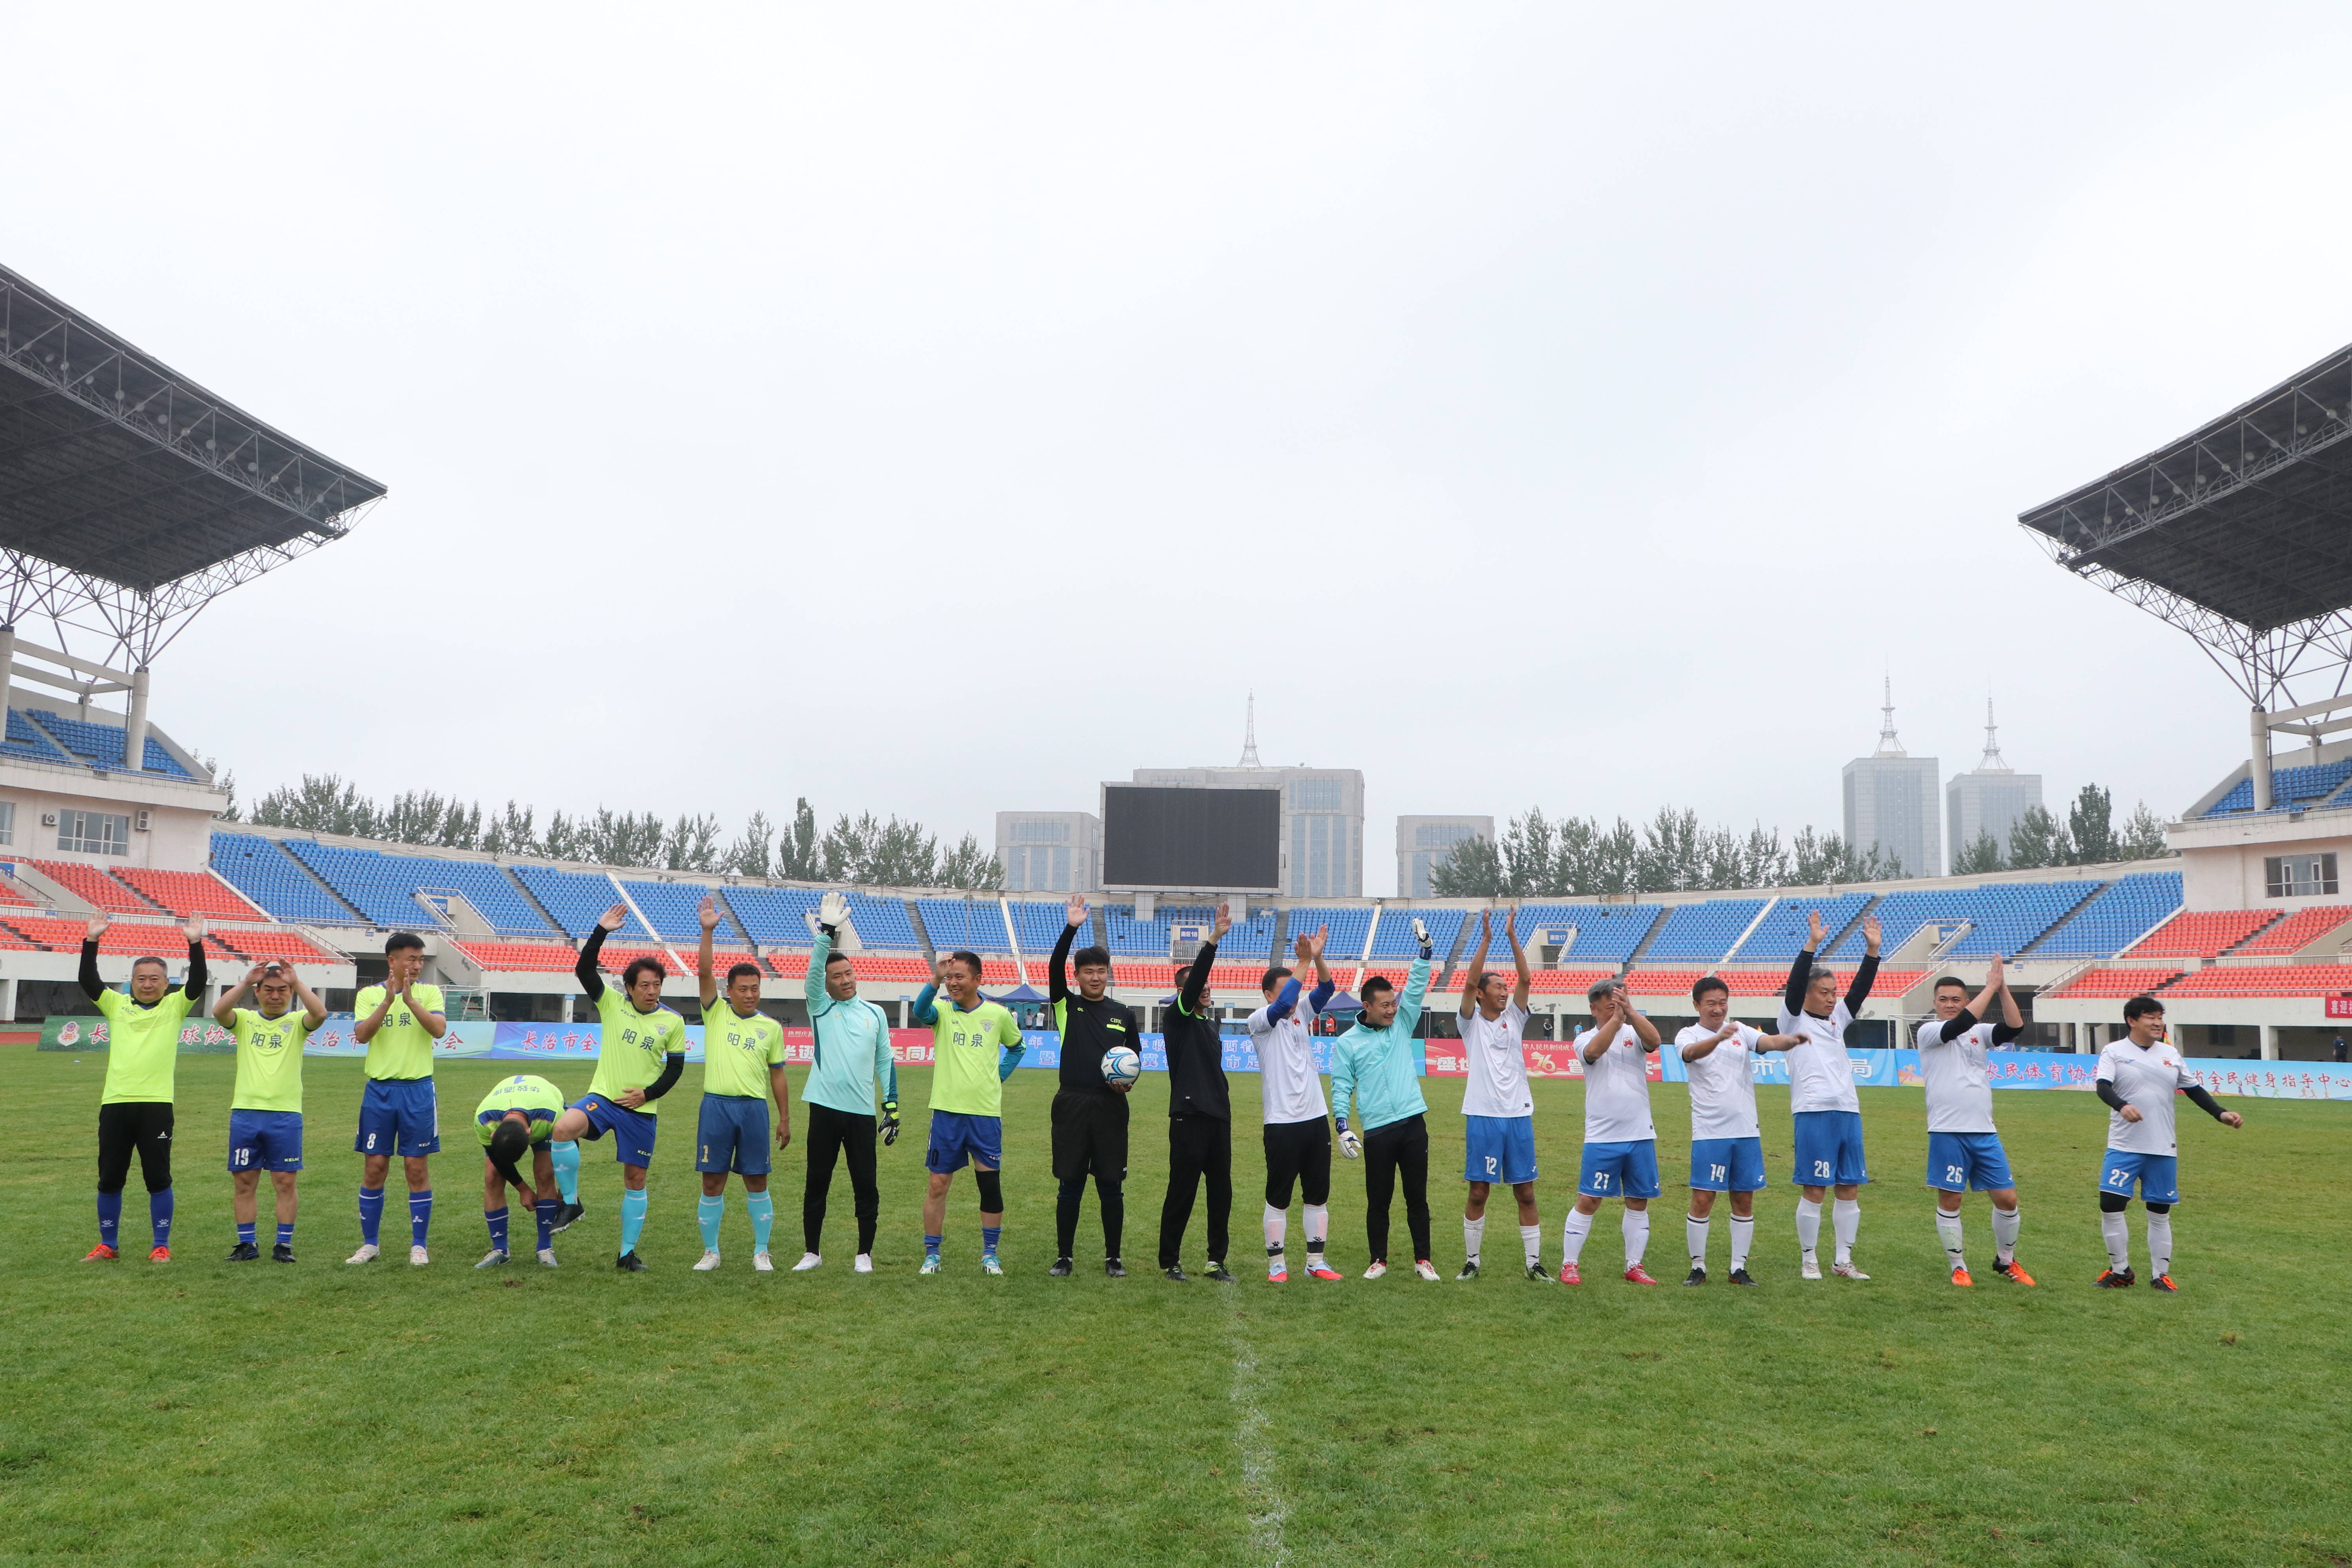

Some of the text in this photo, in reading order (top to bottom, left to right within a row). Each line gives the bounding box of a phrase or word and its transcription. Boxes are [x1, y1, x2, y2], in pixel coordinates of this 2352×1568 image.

[621, 1009, 637, 1019] KELME
[251, 1032, 282, 1048] 阳泉
[622, 1028, 655, 1051] 阳泉
[727, 1033, 756, 1051] 阳泉
[953, 1032, 984, 1047] 阳泉
[586, 1102, 599, 1111] 3
[367, 1133, 376, 1149] 8
[235, 1148, 249, 1166] 19
[1485, 1156, 1497, 1175] 12
[1710, 1163, 1726, 1183] 14
[1814, 1160, 1830, 1178] 28
[1946, 1165, 1963, 1183] 26
[2109, 1169, 2130, 1187] 27
[1593, 1172, 1610, 1190] 21
